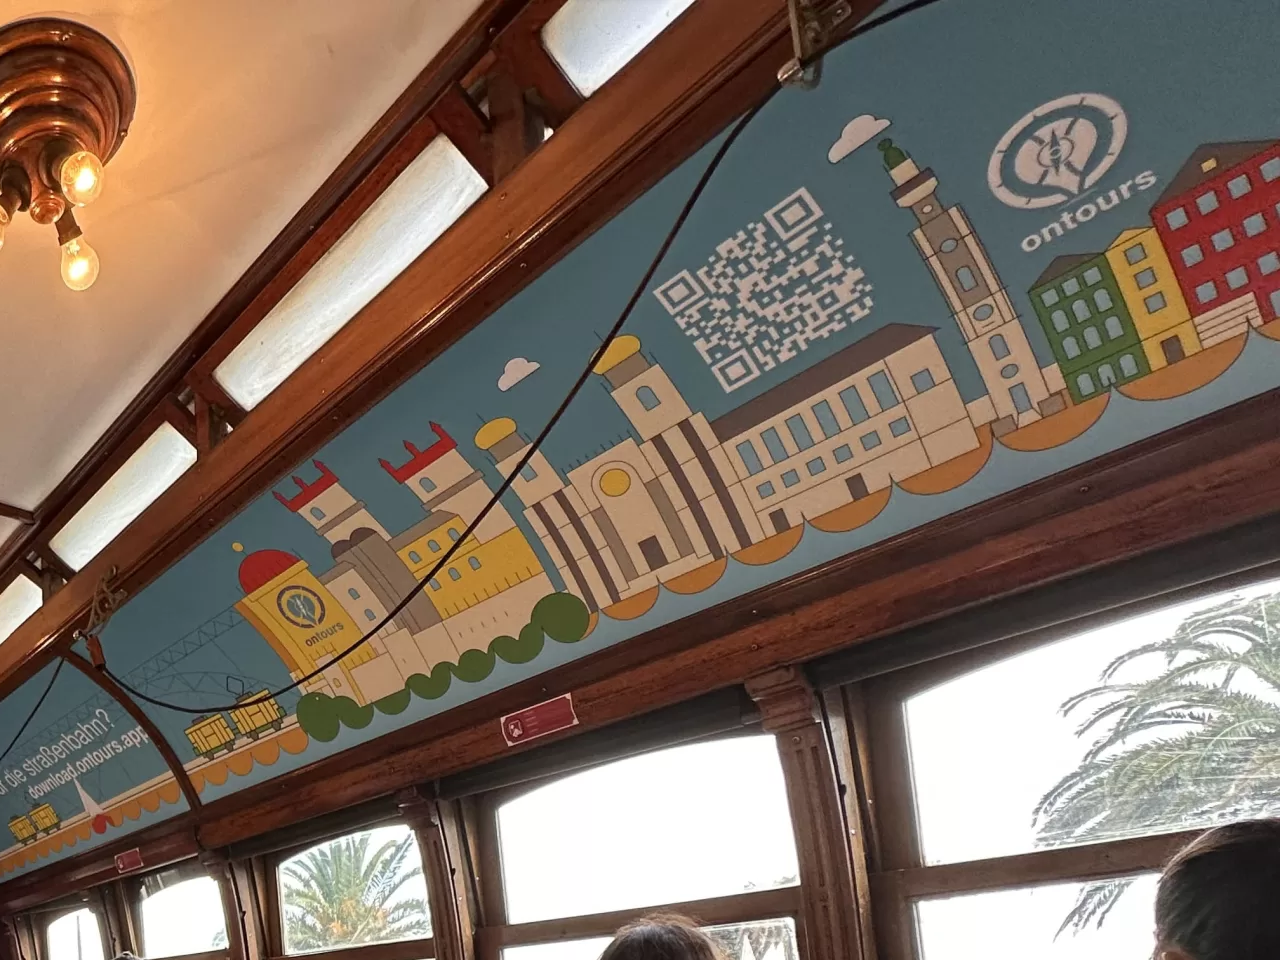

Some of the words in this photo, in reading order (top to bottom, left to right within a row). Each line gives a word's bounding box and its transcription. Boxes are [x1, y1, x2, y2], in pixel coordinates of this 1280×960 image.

[1021, 170, 1157, 252] ontours
[305, 622, 344, 647] ontours
[3, 768, 27, 788] die
[22, 708, 116, 777] straßenbahn?
[28, 725, 150, 800] download.ontours.app
